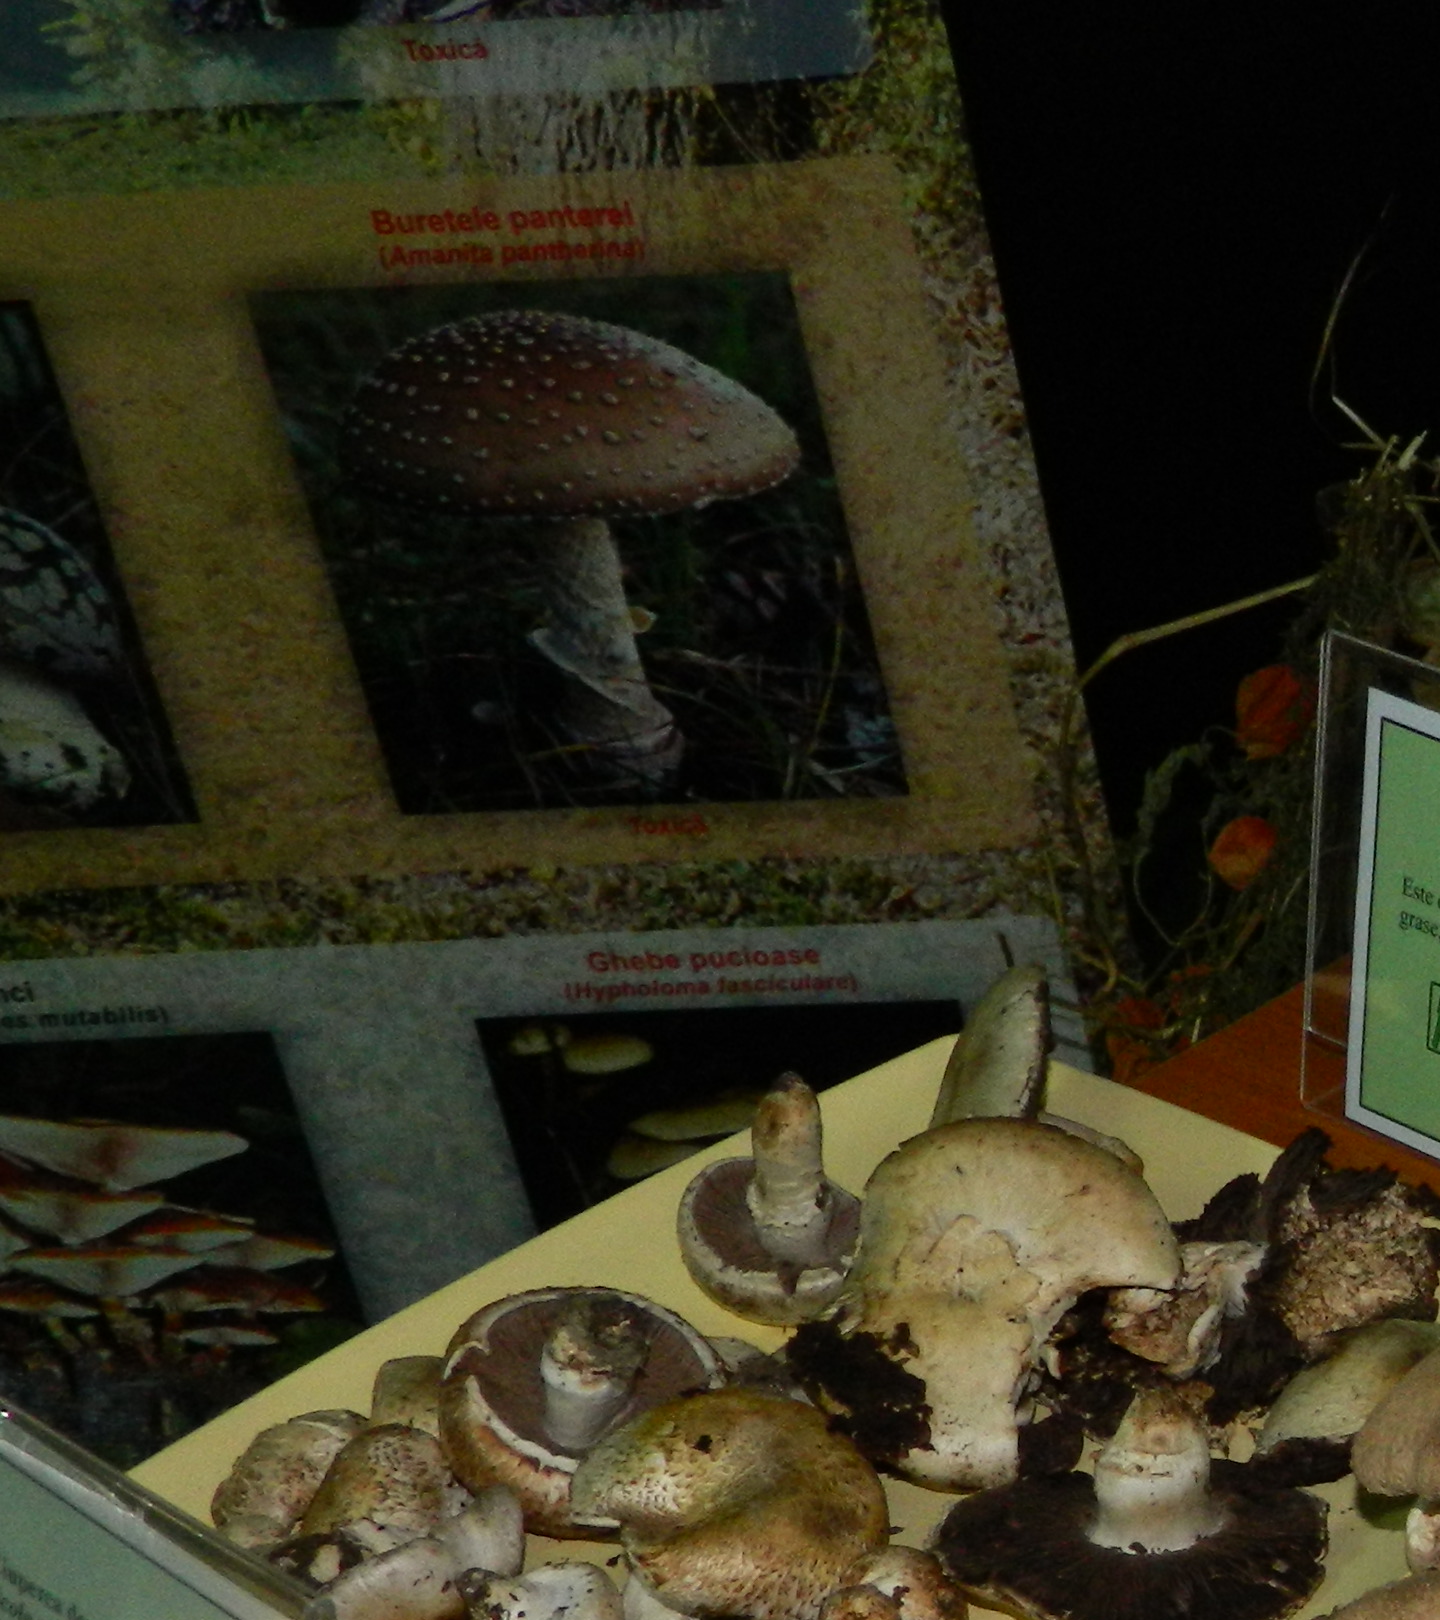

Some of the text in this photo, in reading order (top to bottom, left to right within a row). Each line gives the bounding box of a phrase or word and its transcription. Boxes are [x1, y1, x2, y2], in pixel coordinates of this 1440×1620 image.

[369, 199, 635, 238] Buretele panterei
[1401, 875, 1435, 907] Este
[586, 946, 821, 974] Ghebe pucioase
